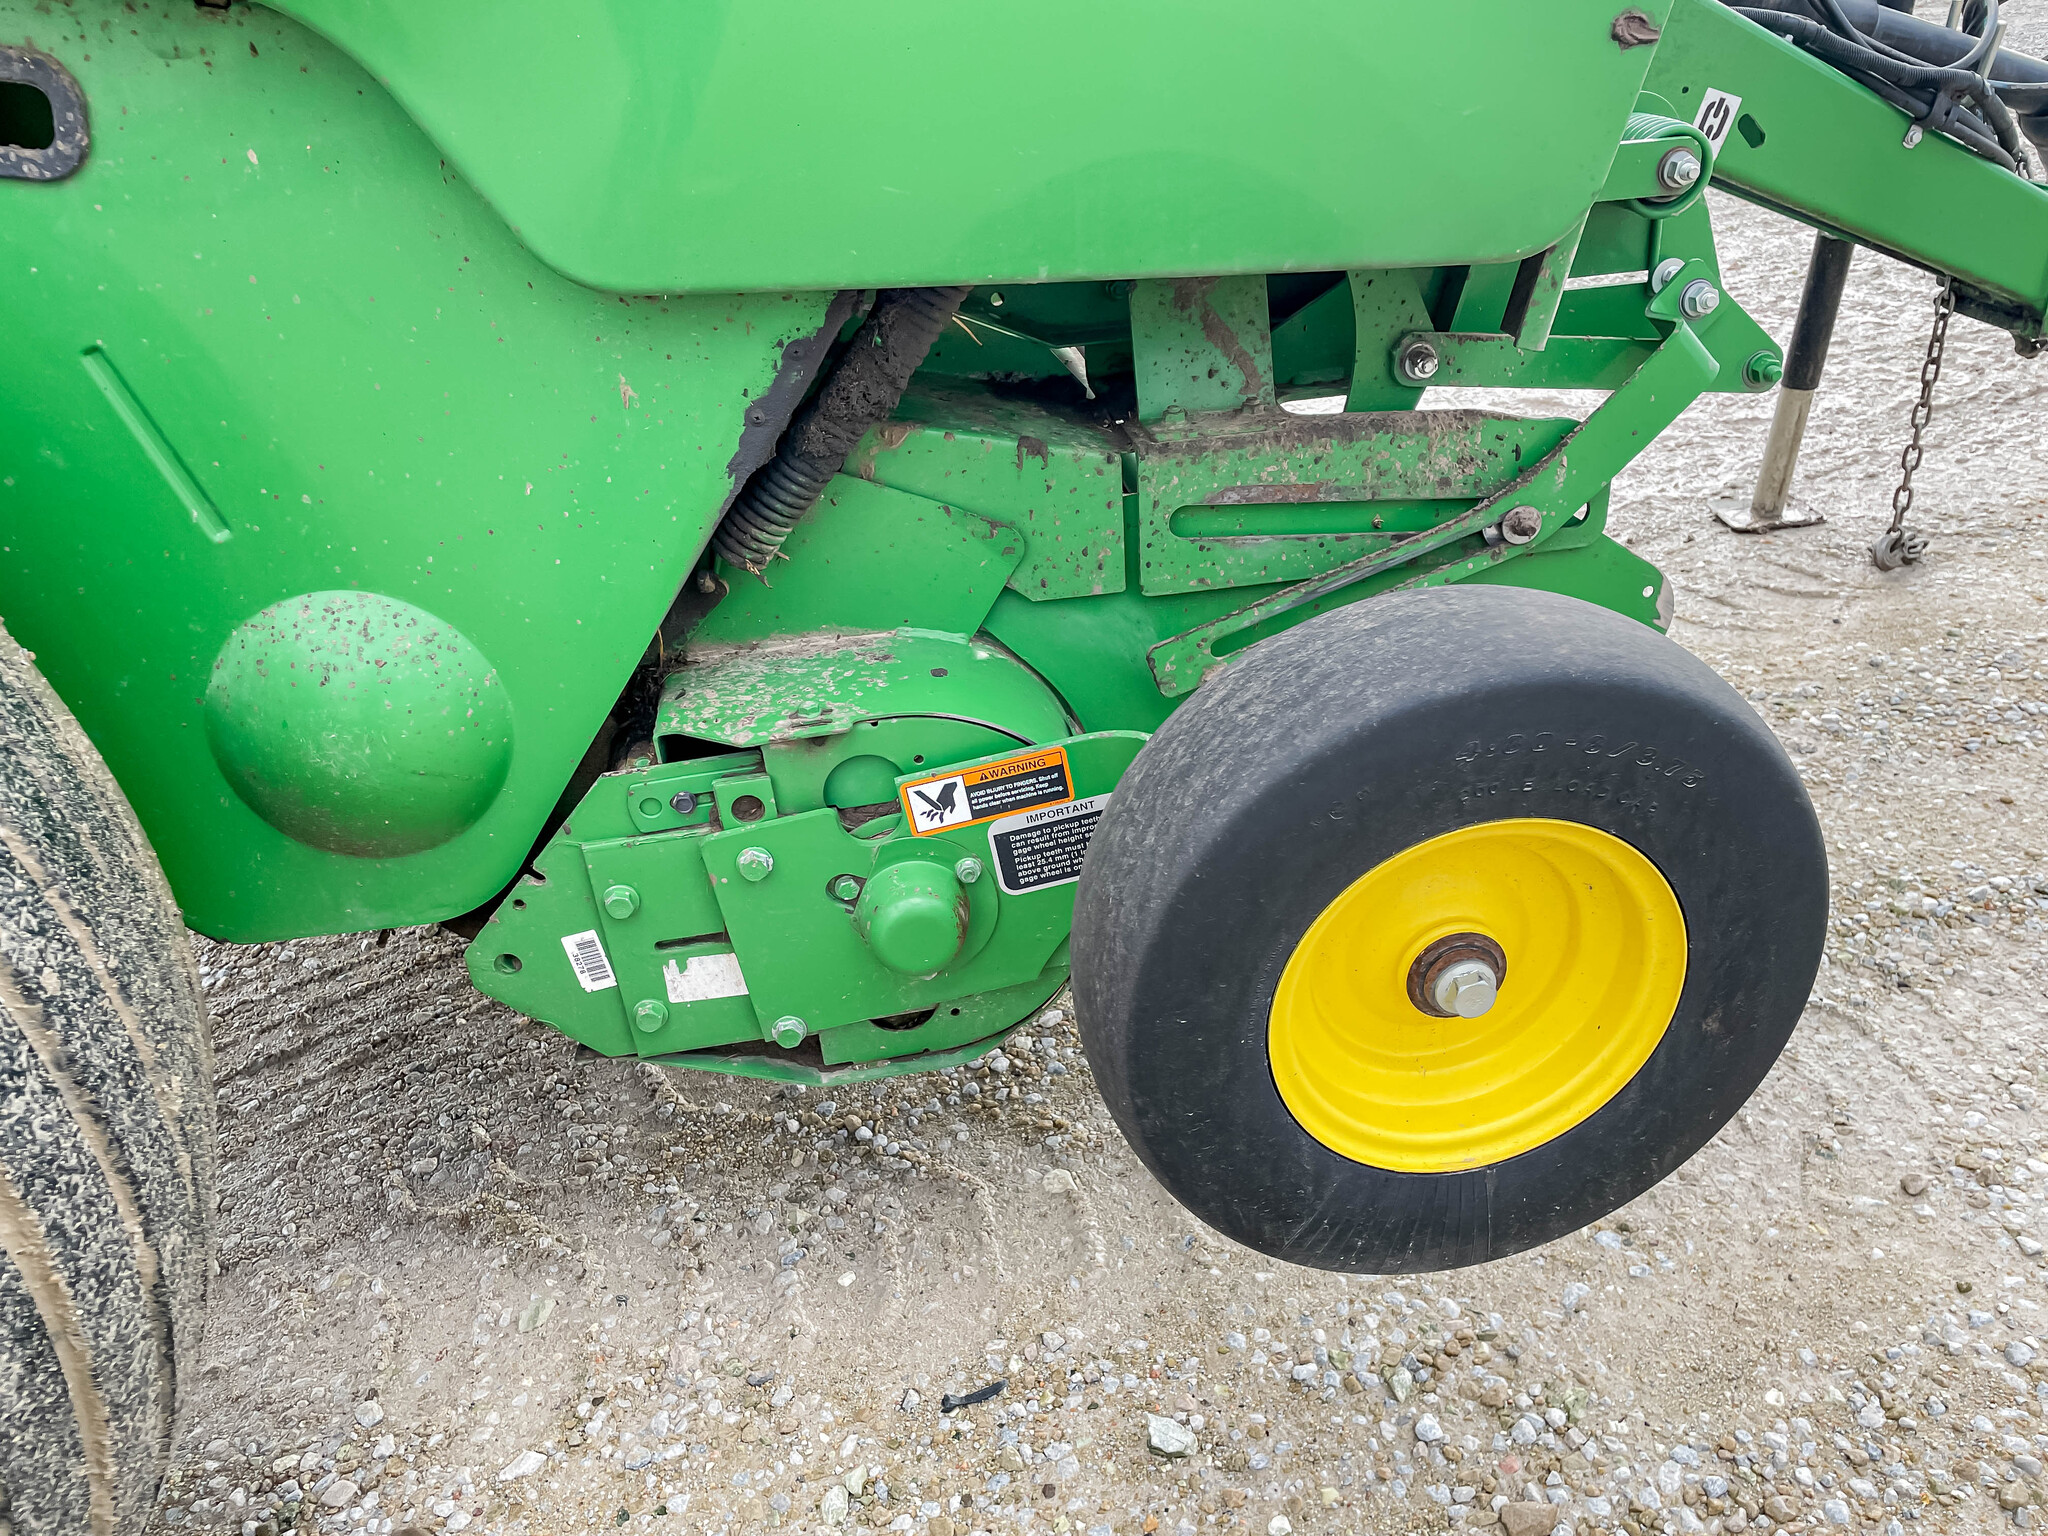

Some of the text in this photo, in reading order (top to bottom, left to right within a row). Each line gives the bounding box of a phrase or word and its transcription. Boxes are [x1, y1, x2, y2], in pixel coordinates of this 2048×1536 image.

[988, 758, 1046, 778] WARNING
[970, 790, 986, 799] AVOID
[986, 785, 1005, 795] INJURY
[978, 796, 994, 804] power
[994, 790, 1011, 799] before
[1035, 782, 1049, 790] Keep
[1002, 796, 1016, 804] when
[1016, 790, 1037, 800] machine
[1043, 785, 1065, 795] running.
[1026, 800, 1095, 824] IMPORTANT
[1009, 829, 1041, 842] Damage
[1053, 821, 1079, 832] pickup
[1011, 840, 1026, 849] can
[1027, 834, 1050, 844] result
[1051, 829, 1070, 839] from
[1012, 847, 1031, 857] gage
[1033, 840, 1056, 850] wheel
[1058, 832, 1083, 844] height
[1014, 853, 1041, 865] Pickup
[1043, 847, 1063, 858] teeth
[1065, 842, 1084, 853] must
[1016, 861, 1036, 871] least
[1036, 856, 1053, 866] 25.4
[1054, 853, 1069, 862] mm
[1071, 851, 1078, 859] (1
[1017, 867, 1041, 878] above
[1043, 860, 1071, 873] ground
[1019, 875, 1038, 885] gage
[1040, 868, 1063, 879] wheel
